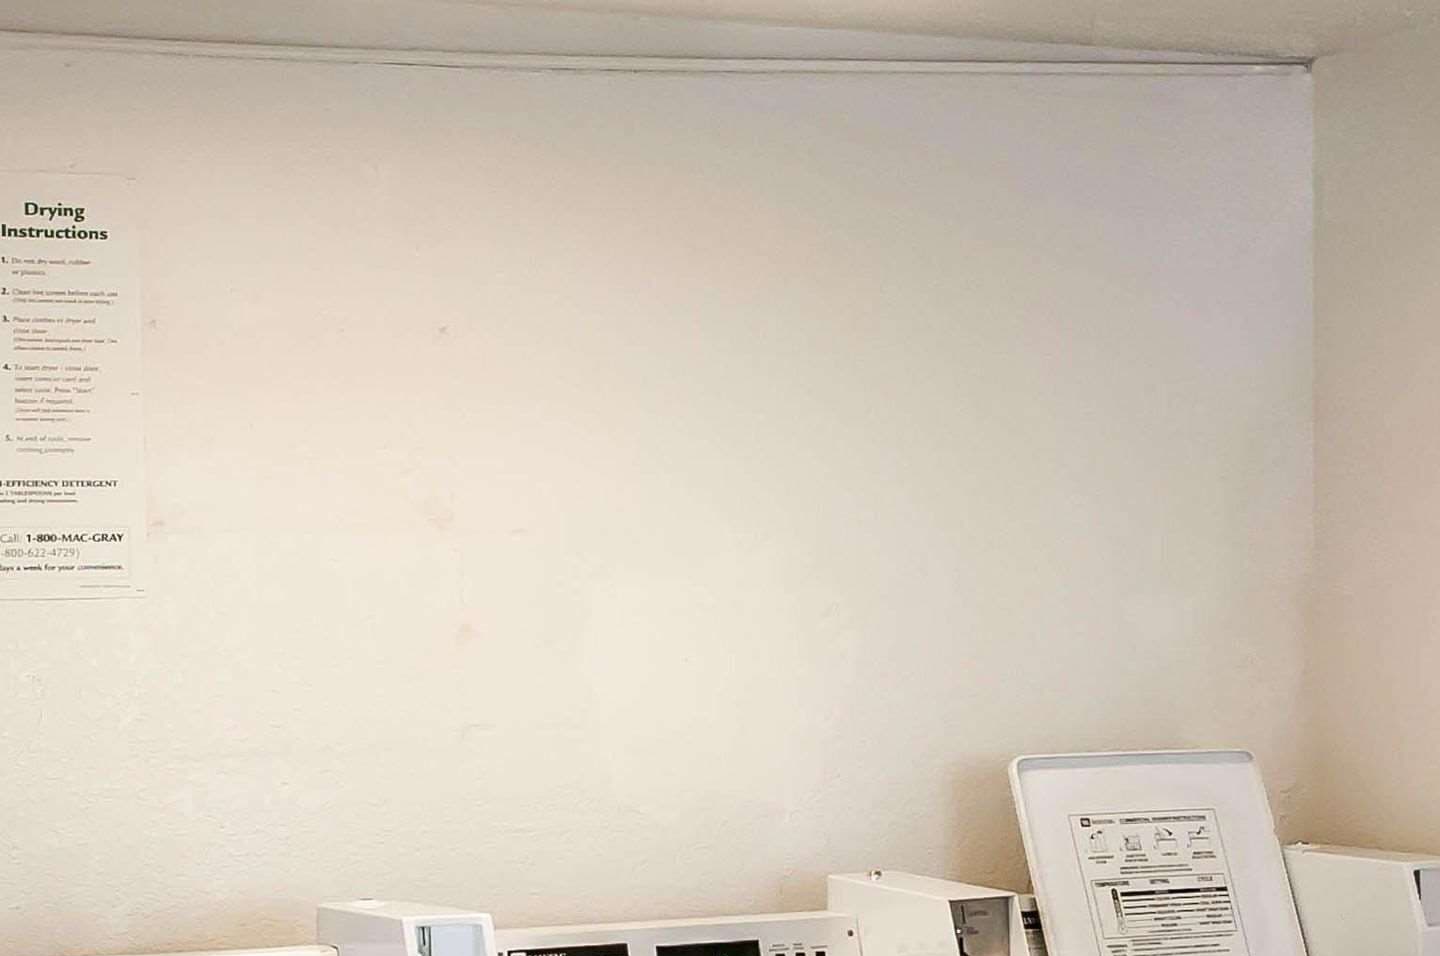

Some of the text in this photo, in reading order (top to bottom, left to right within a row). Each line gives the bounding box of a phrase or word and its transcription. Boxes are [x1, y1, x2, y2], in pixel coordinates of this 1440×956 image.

[24, 202, 85, 222] Drying
[1, 224, 109, 240] Instructions
[26, 533, 124, 542] 1-800-MAC-GRAY
